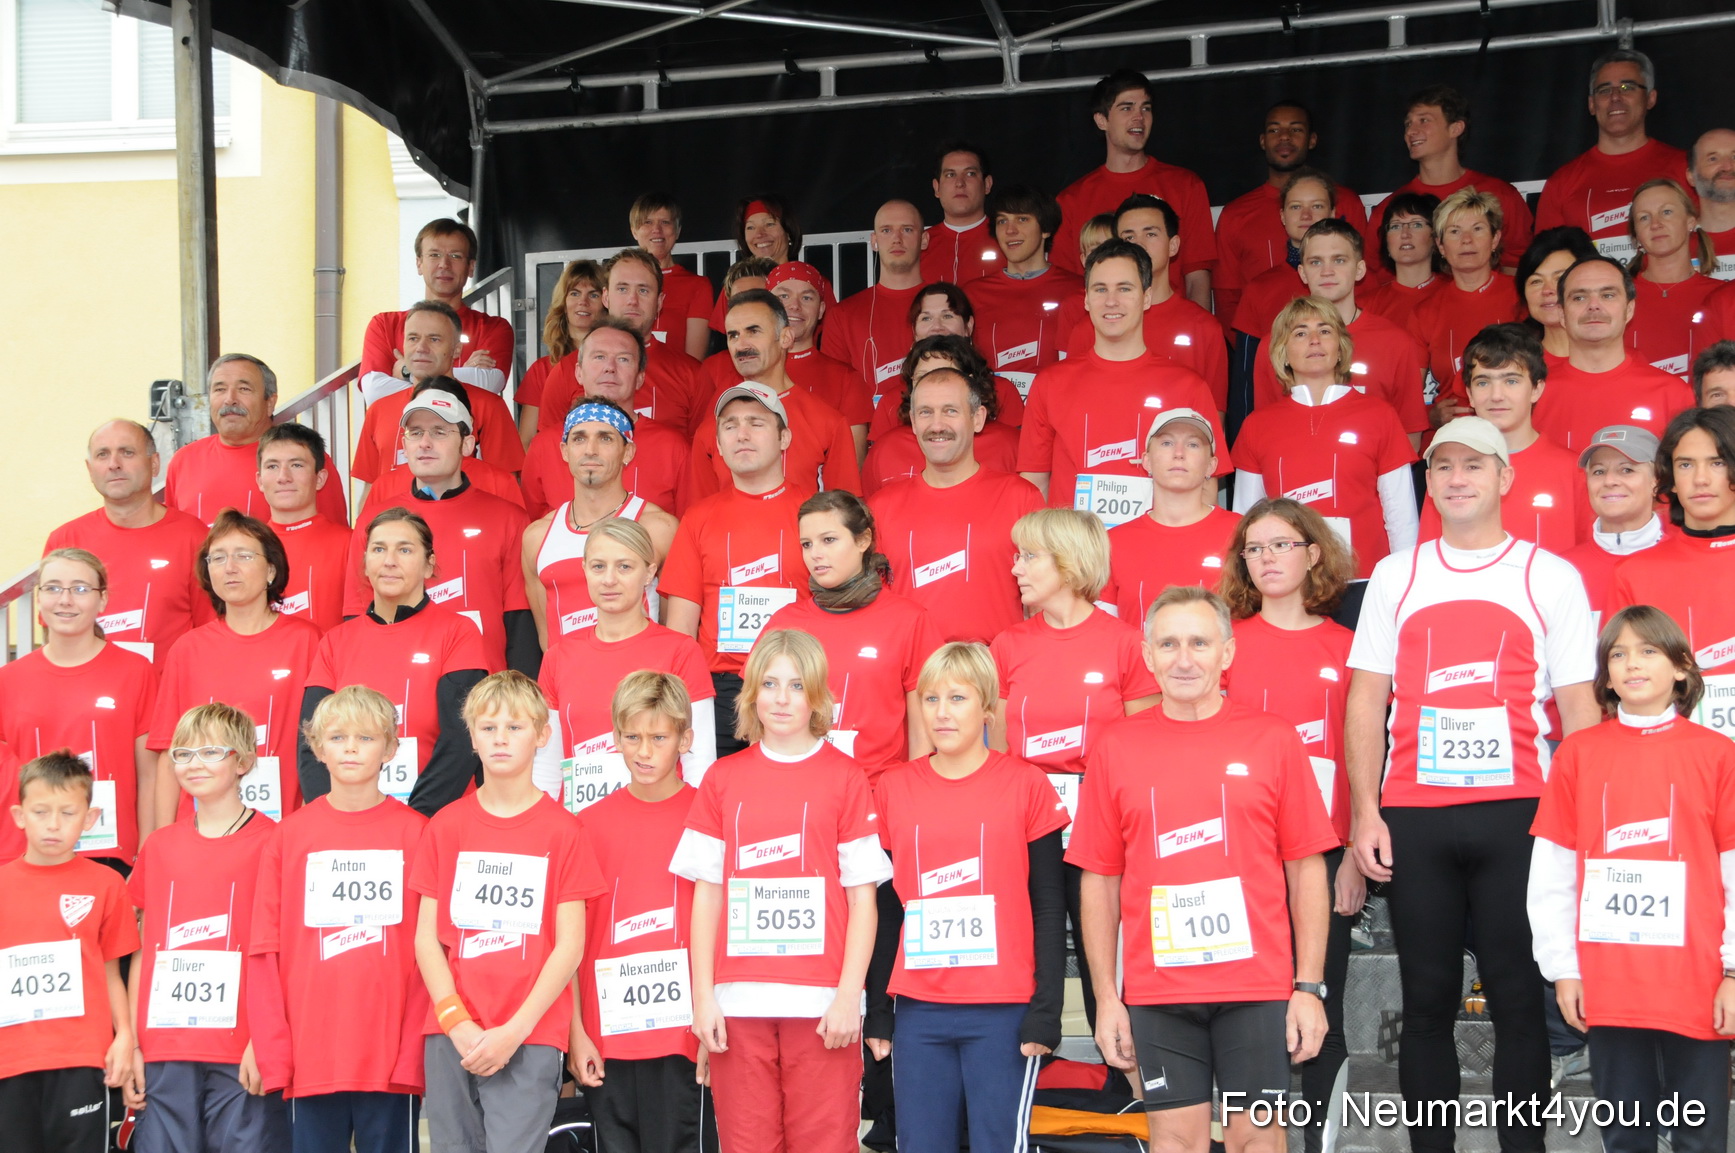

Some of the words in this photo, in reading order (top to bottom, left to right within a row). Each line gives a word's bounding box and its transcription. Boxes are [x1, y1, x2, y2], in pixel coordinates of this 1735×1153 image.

[1604, 211, 1626, 224] DEHN
[1008, 348, 1026, 360] DEHN
[1100, 447, 1122, 459] DEHN
[1096, 479, 1128, 495] Philipp
[1296, 487, 1319, 502] DEHN
[1079, 496, 1085, 506] B
[1096, 497, 1143, 516] 2007
[745, 562, 765, 577] DEHN
[929, 560, 951, 578] DEHN
[738, 593, 770, 606] Rainer
[104, 617, 127, 630] DEHN
[572, 613, 595, 627] DEHN
[722, 611, 727, 621] C
[1444, 668, 1476, 682] DEHN
[1440, 716, 1475, 732] Oliver
[586, 739, 608, 755] DEHN
[1041, 735, 1067, 749] DEHN
[1422, 736, 1428, 747] C
[1442, 738, 1500, 760] 2332
[575, 763, 603, 777] Ervina
[1475, 774, 1511, 783] PFLEIDERER
[1176, 829, 1205, 846] DEHN
[1620, 828, 1649, 841] DEHN
[756, 844, 784, 859] DEHN
[331, 858, 366, 873] Anton
[477, 859, 513, 876] Daniel
[937, 868, 963, 885] DEHN
[1606, 866, 1642, 884] Tizian
[332, 881, 393, 901] 4036
[474, 883, 535, 908] 4035
[754, 885, 810, 900] Marianne
[1172, 890, 1207, 909] Josef
[1605, 893, 1669, 918] 4021
[732, 908, 738, 919] S
[756, 908, 816, 930] 5053
[630, 917, 657, 932] DEHN
[929, 917, 983, 940] 3718
[1154, 917, 1160, 929] C
[1185, 912, 1231, 938] 100
[183, 924, 211, 939] DEHN
[340, 929, 367, 946] DEHN
[478, 934, 505, 949] DEHN
[8, 953, 55, 969] Thomas
[960, 952, 995, 961] PFLEIDERER
[172, 957, 206, 973] Oliver
[619, 958, 678, 978] Alexander
[11, 972, 72, 998] 4032
[171, 981, 226, 1003] 4031
[623, 981, 681, 1006] 4026
[655, 1013, 691, 1023] PFLEIDERER
